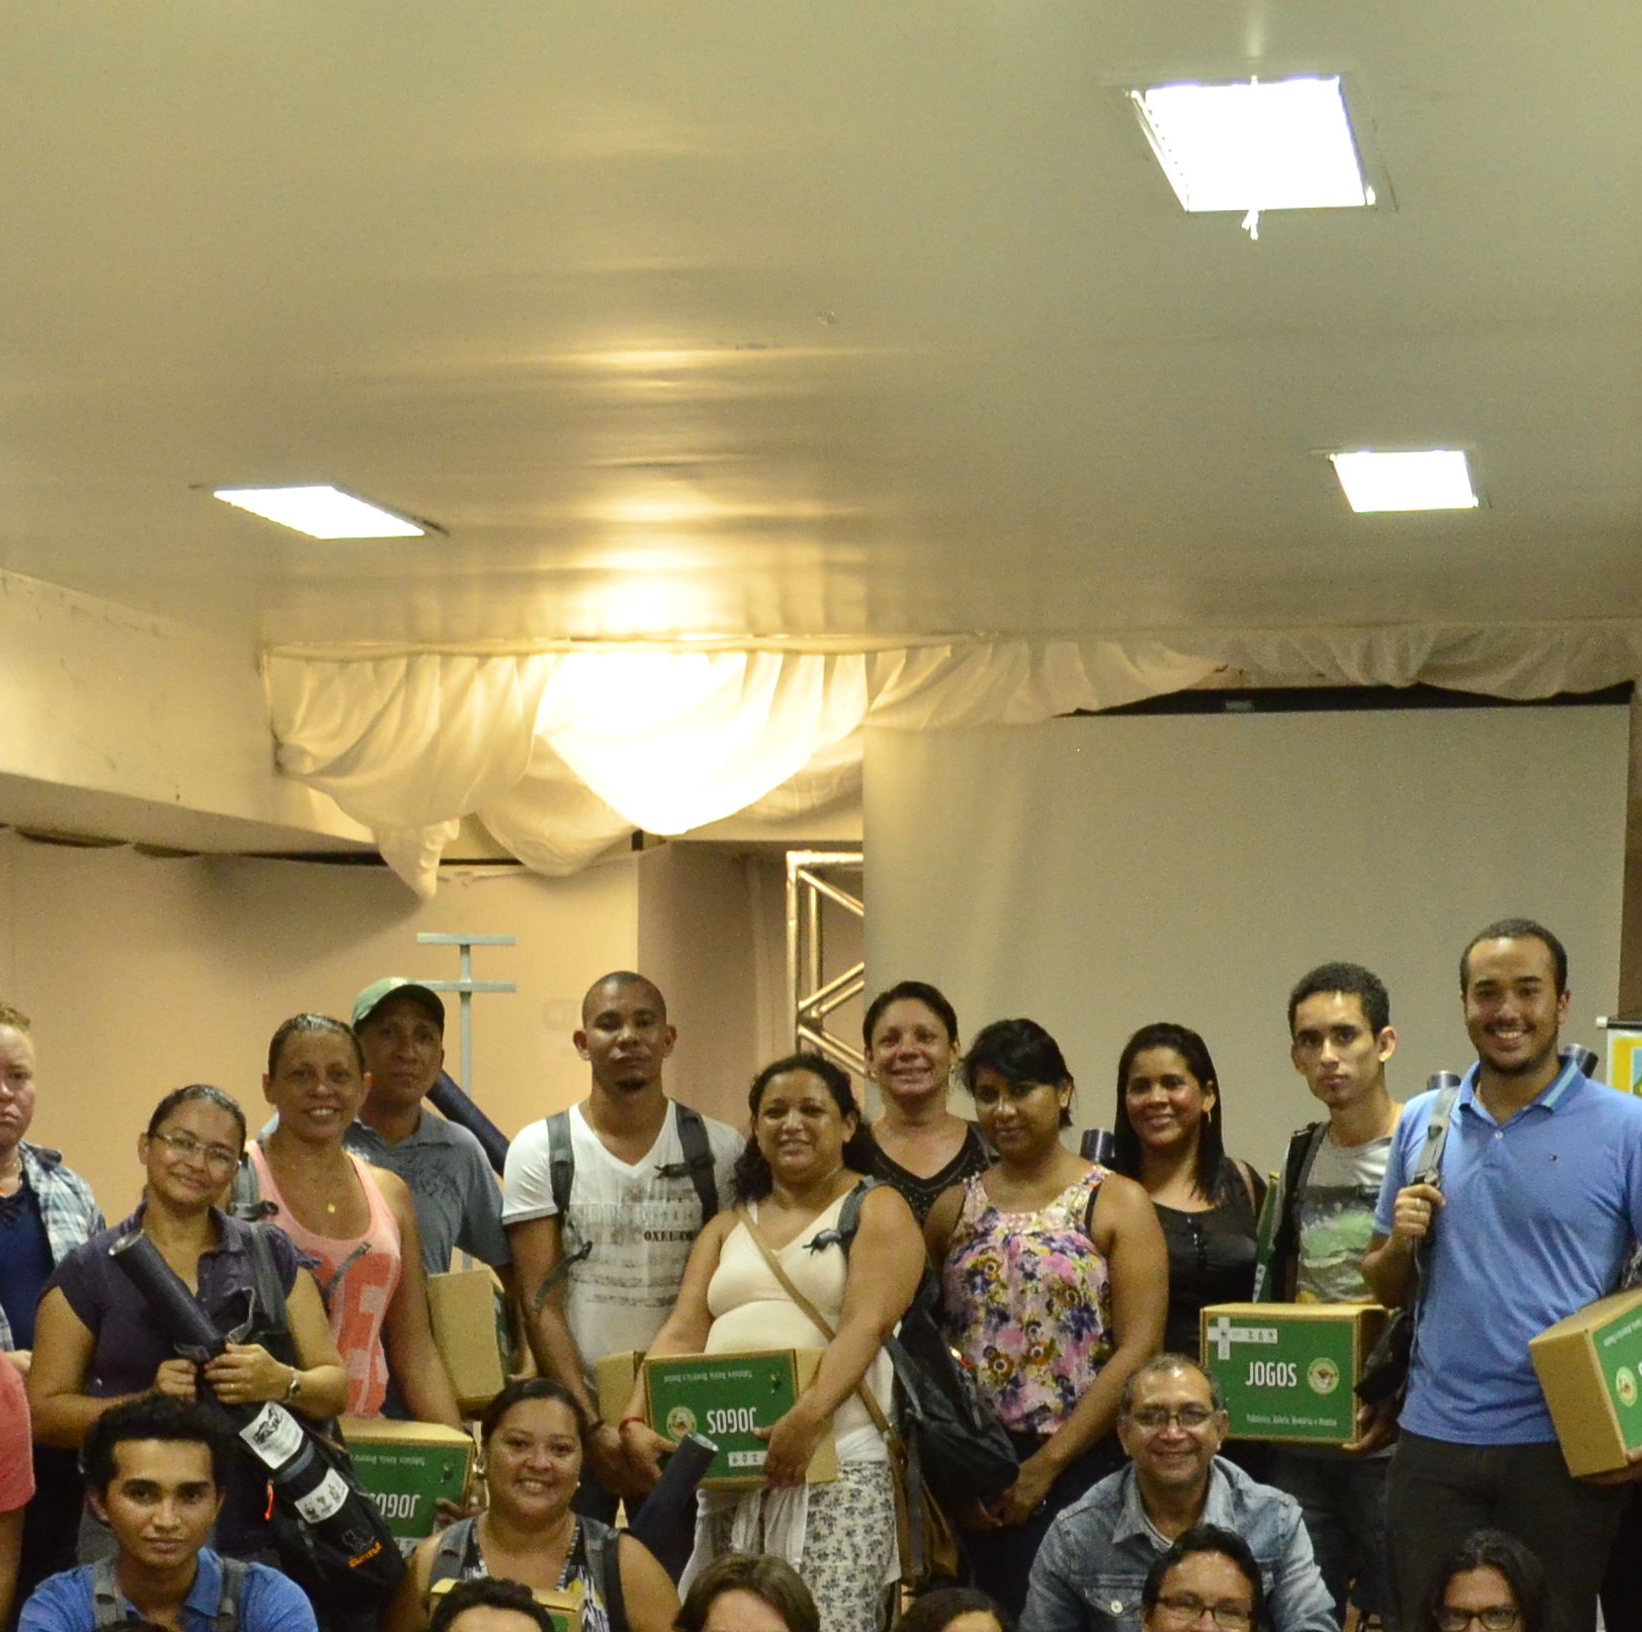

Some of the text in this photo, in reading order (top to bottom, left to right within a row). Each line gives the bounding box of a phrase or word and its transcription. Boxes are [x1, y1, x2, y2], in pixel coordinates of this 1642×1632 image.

[1245, 1361, 1298, 1388] JOGOS
[706, 1406, 757, 1435] JOGOS
[369, 1492, 422, 1519] JOGO
